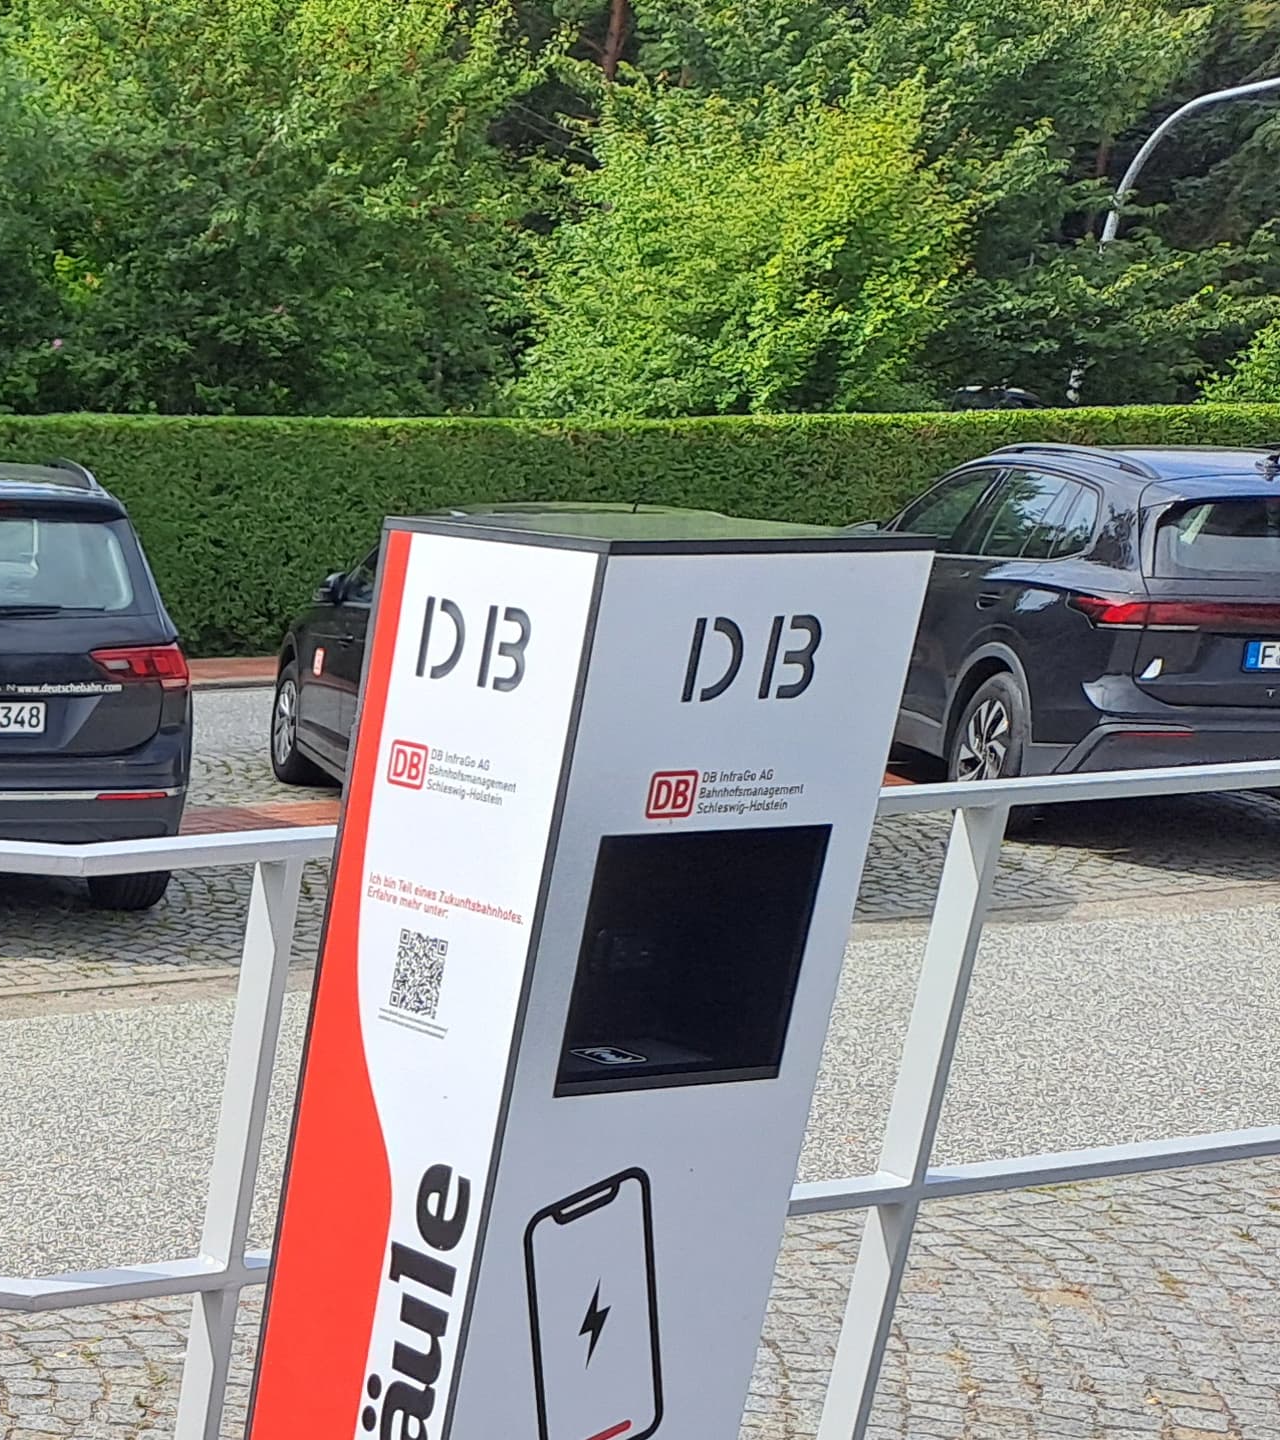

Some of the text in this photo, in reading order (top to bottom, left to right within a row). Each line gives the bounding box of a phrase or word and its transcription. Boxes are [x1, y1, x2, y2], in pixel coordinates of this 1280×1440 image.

[415, 596, 532, 693] DB
[680, 613, 823, 703] DB
[17, 682, 123, 695] www.deutschebahn.com
[392, 747, 422, 781] DB
[431, 748, 443, 762] DB
[477, 758, 491, 772] AG
[428, 763, 517, 793] Bahnhofsmanagement
[702, 771, 717, 784] DB
[758, 768, 775, 781] AG
[426, 778, 503, 806] Schleswig-Holstein
[652, 779, 690, 811] DB
[699, 783, 805, 800] Bahnhofsmanagement
[696, 800, 789, 815] Schleswig-Holstein
[367, 886, 398, 905] Erfahre
[399, 896, 423, 911] mehr
[369, 872, 382, 886] Ich
[383, 877, 397, 889] bin
[398, 879, 413, 895] Teil
[414, 885, 437, 902] eines
